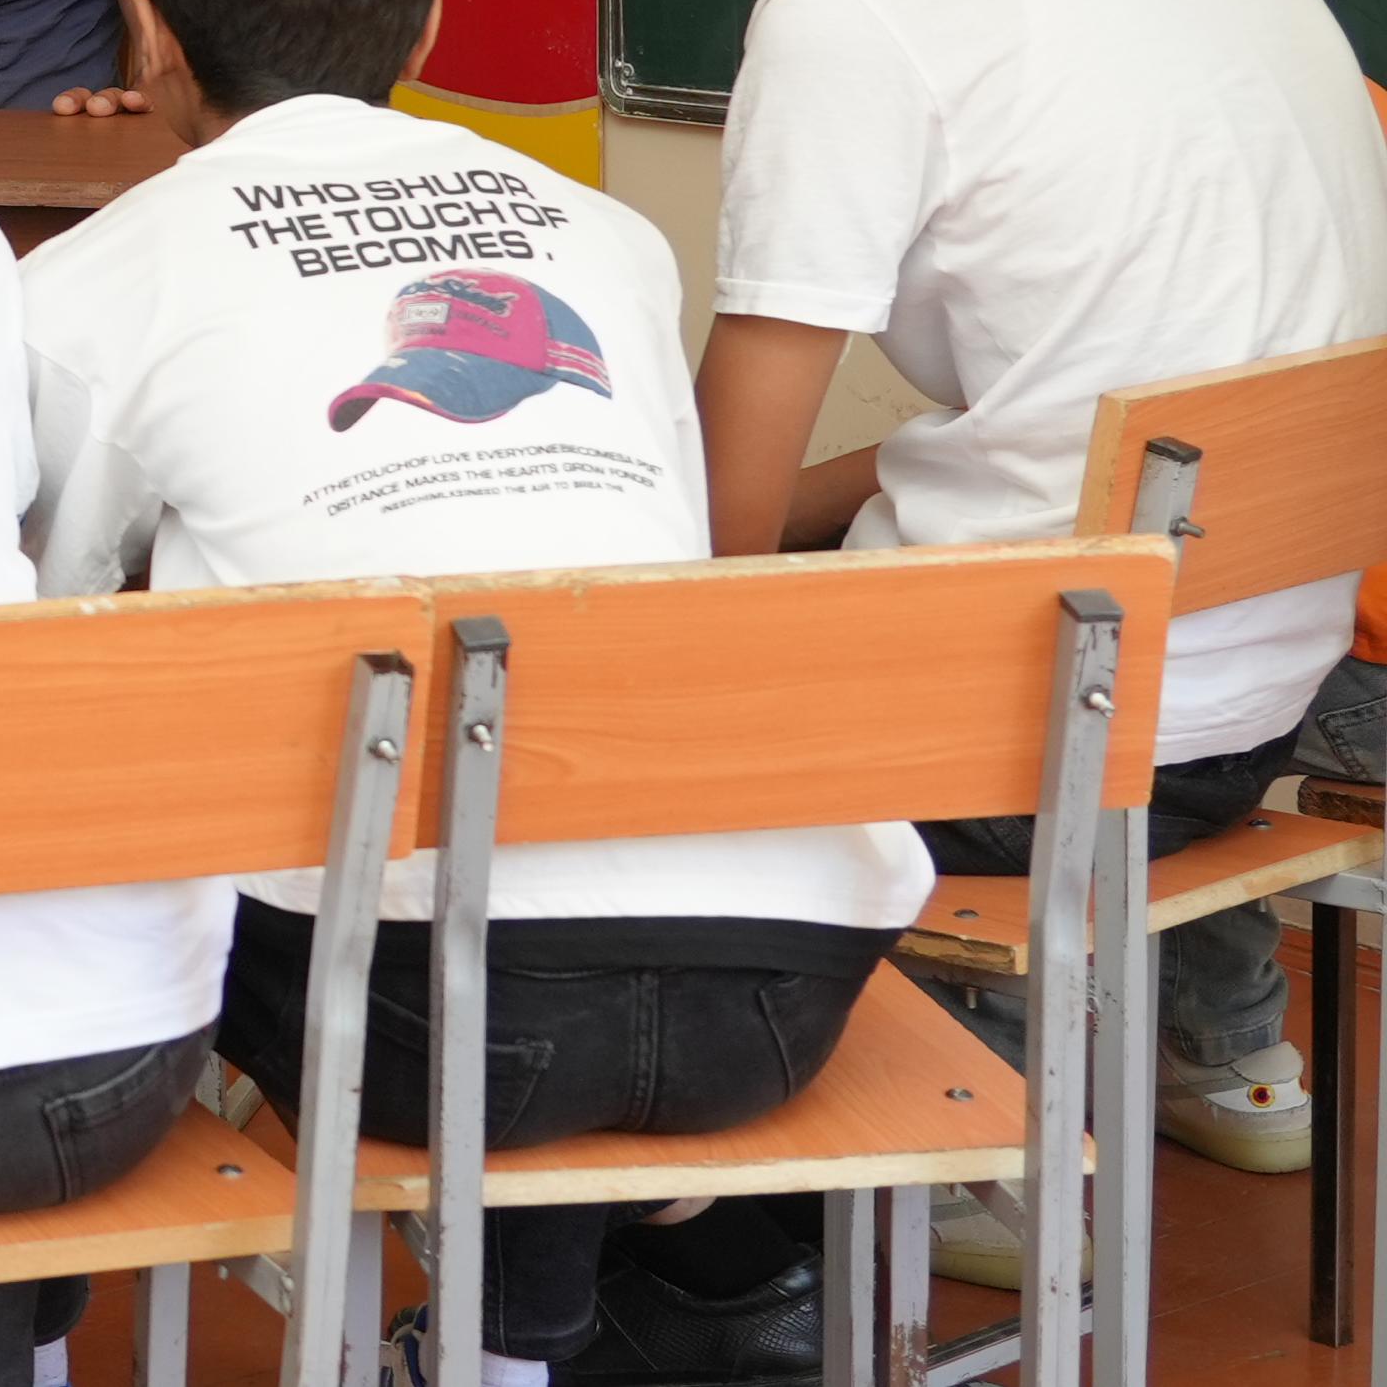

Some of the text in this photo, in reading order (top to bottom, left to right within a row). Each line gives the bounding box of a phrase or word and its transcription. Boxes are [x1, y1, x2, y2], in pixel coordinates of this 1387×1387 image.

[232, 182, 361, 212] WHO
[230, 200, 570, 249] THE TOUCH OF
[464, 469, 493, 480] THE
